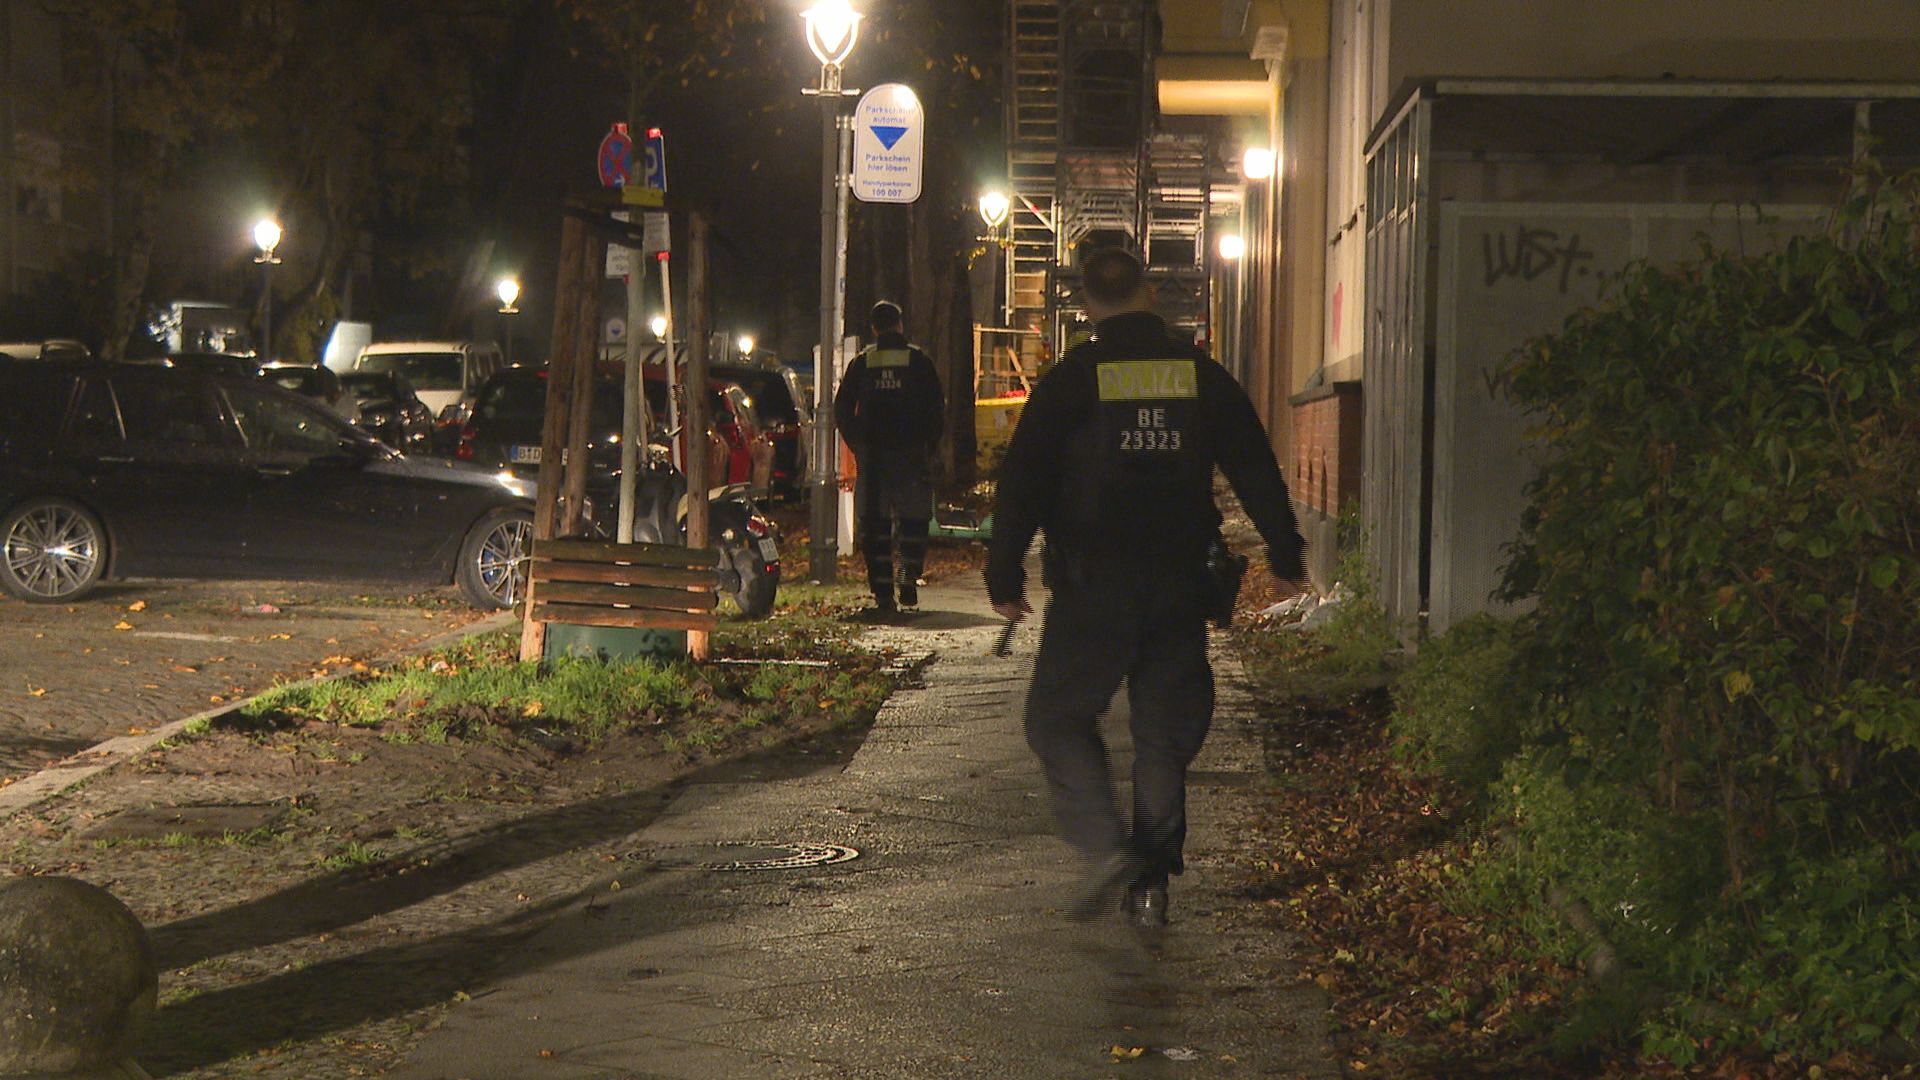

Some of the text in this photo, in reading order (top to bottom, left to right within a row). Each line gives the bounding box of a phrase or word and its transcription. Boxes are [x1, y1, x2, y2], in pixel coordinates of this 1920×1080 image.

[866, 154, 911, 163] Parkschein
[868, 163, 908, 172] hier lösen
[1138, 408, 1165, 428] BE
[1120, 430, 1181, 450] 23323
